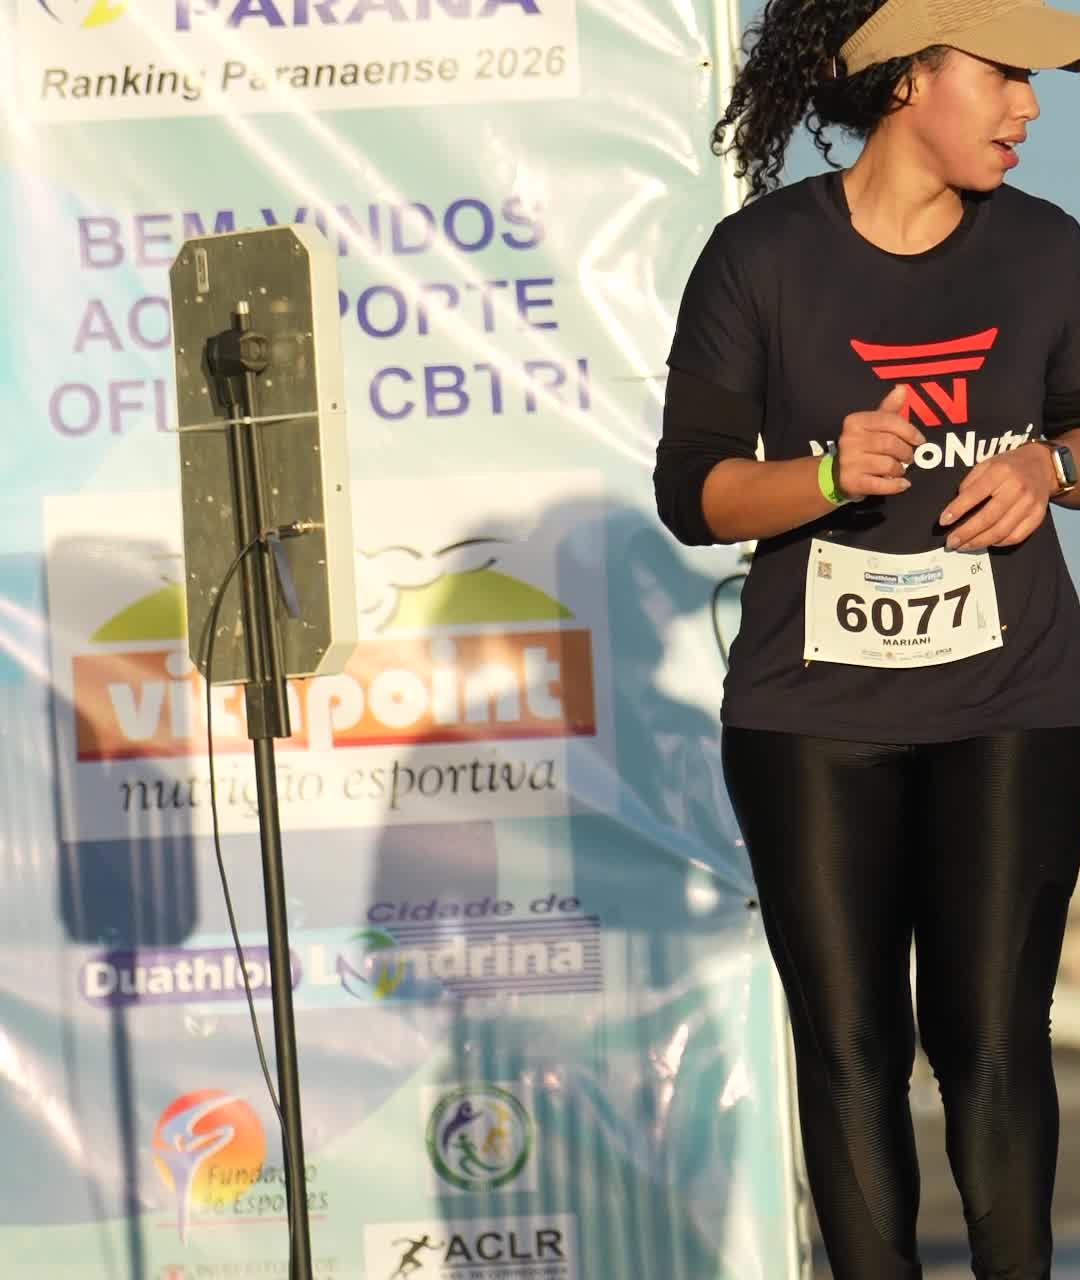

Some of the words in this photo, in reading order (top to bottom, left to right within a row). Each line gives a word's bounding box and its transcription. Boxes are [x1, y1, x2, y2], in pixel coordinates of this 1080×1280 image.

[42, 64, 205, 102] Ranking
[474, 45, 567, 81] 2026
[369, 358, 592, 422] CBTRI
[970, 561, 983, 575] 6K
[836, 584, 971, 637] 6077
[883, 636, 931, 646] MARIANI
[343, 755, 558, 813] esportiva
[367, 897, 515, 923] Cidade
[529, 893, 582, 914] de
[445, 1228, 563, 1262] ACLR
